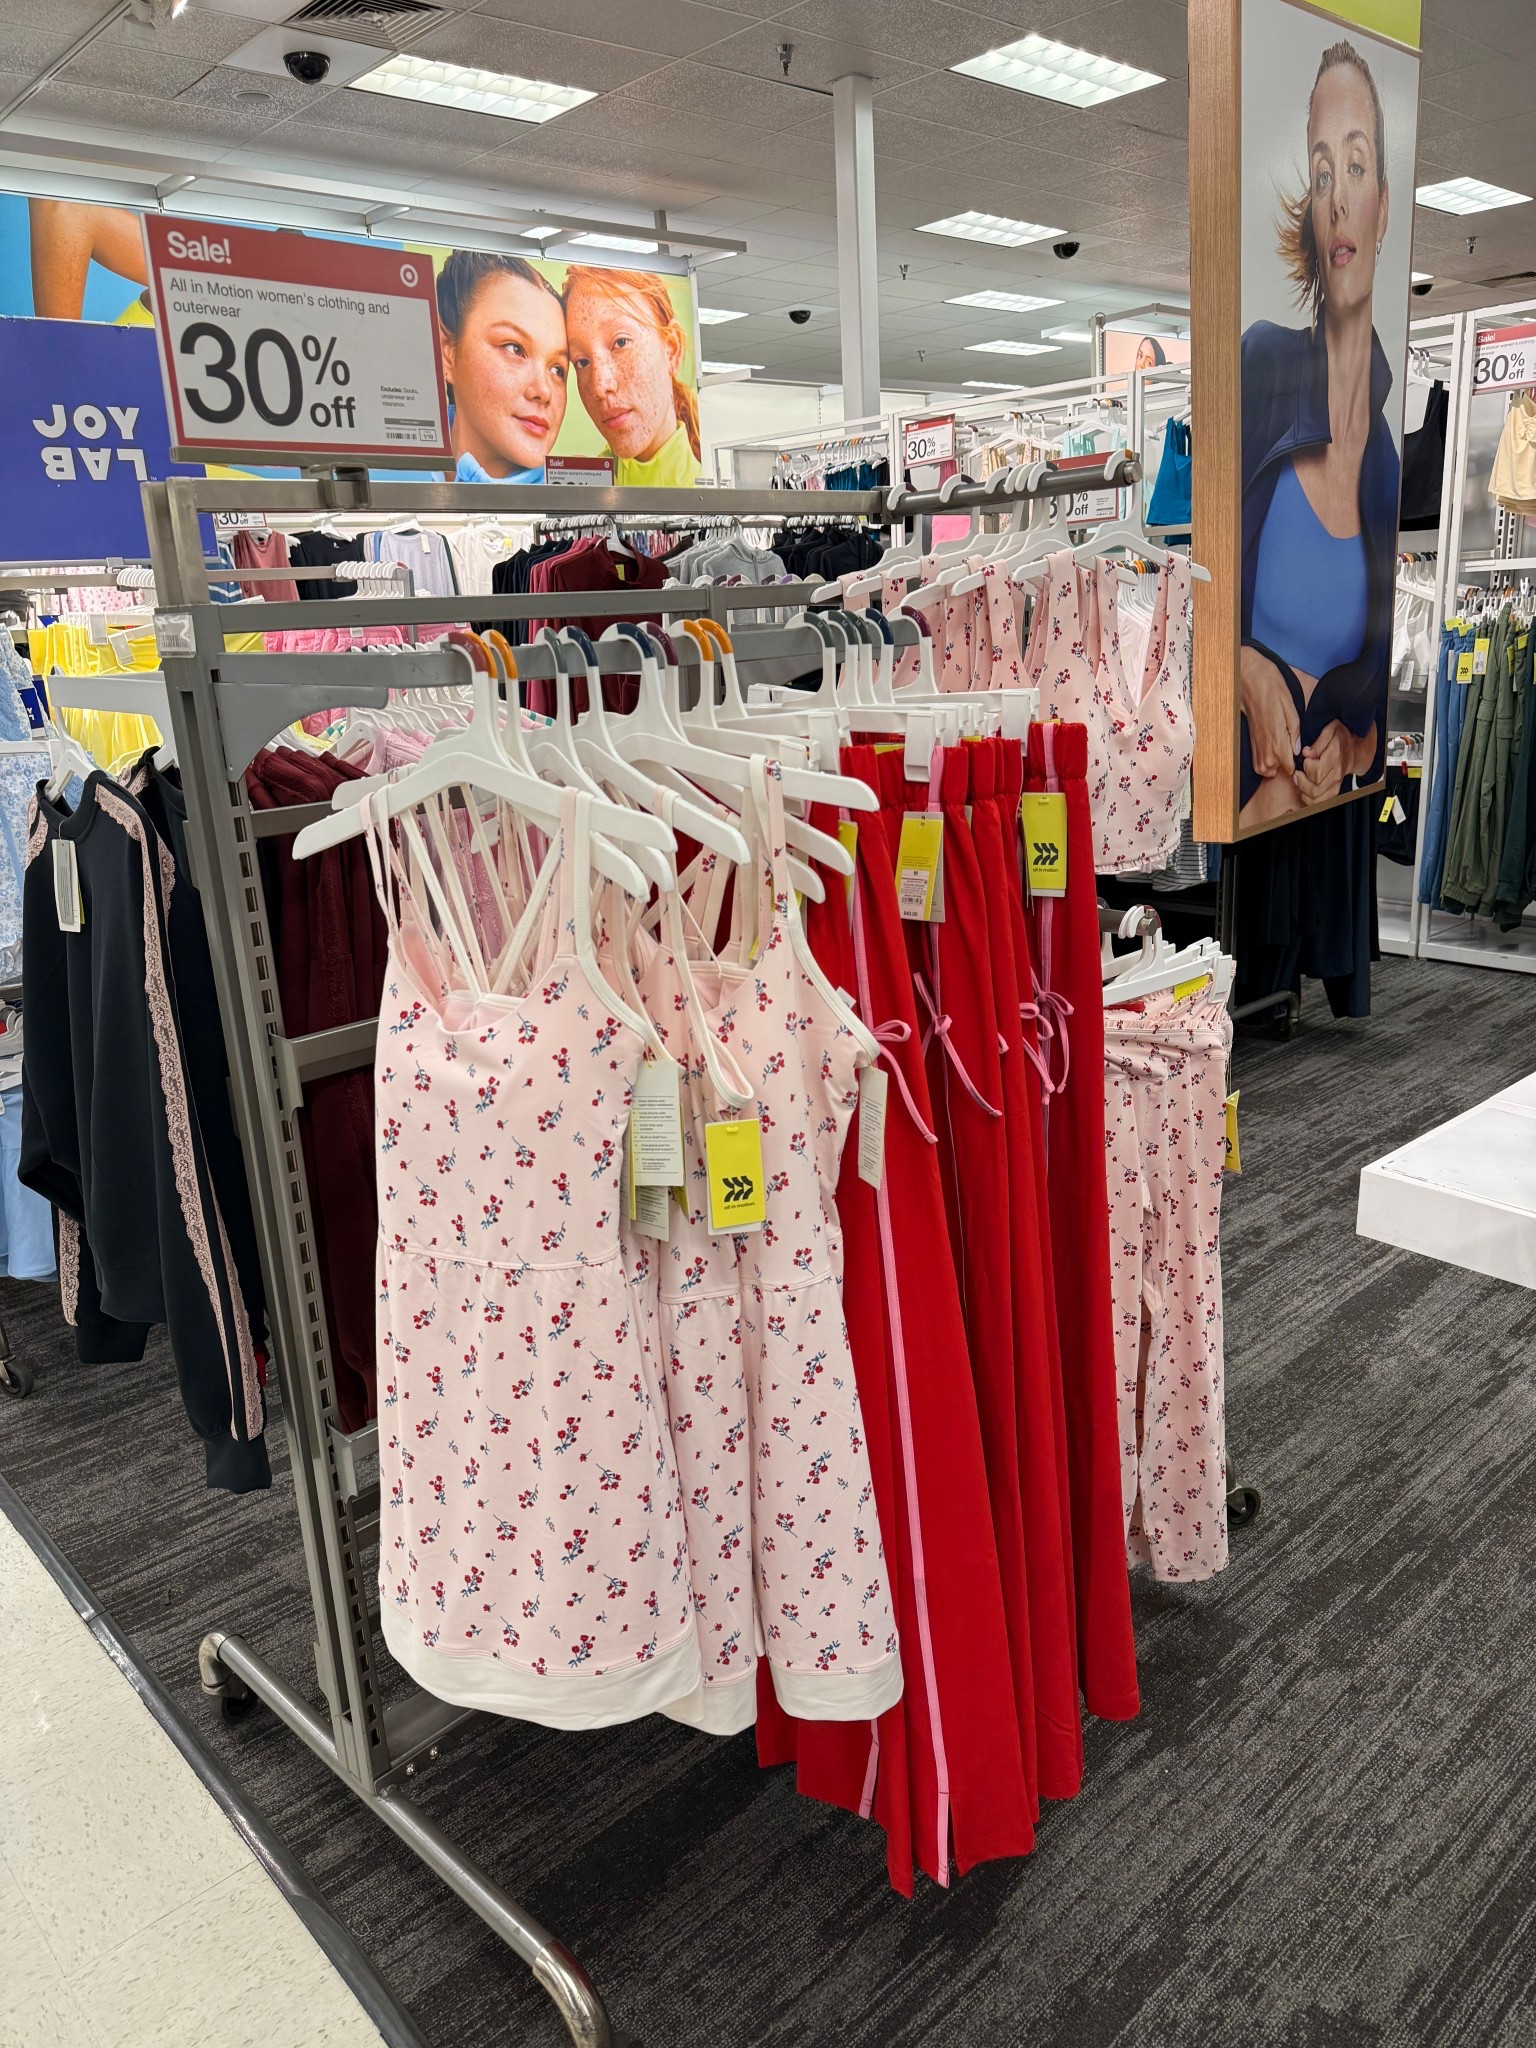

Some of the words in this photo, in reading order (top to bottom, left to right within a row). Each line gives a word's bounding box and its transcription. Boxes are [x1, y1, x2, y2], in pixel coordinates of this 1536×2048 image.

[167, 231, 232, 264] Sale!
[170, 277, 187, 292] All
[190, 279, 203, 294] in
[207, 281, 253, 300] Motion
[256, 290, 314, 306] women's
[318, 294, 365, 315] clothing
[368, 302, 390, 315] and
[173, 301, 241, 318] outerwear
[1478, 333, 1496, 343] Sale!
[1508, 368, 1525, 380] off
[310, 395, 357, 429] off
[32, 404, 140, 440] JOY
[926, 448, 936, 457] off
[40, 446, 148, 481] LAB
[549, 459, 565, 467] Sale!
[1074, 503, 1089, 516] off
[464, 640, 473, 652] XS
